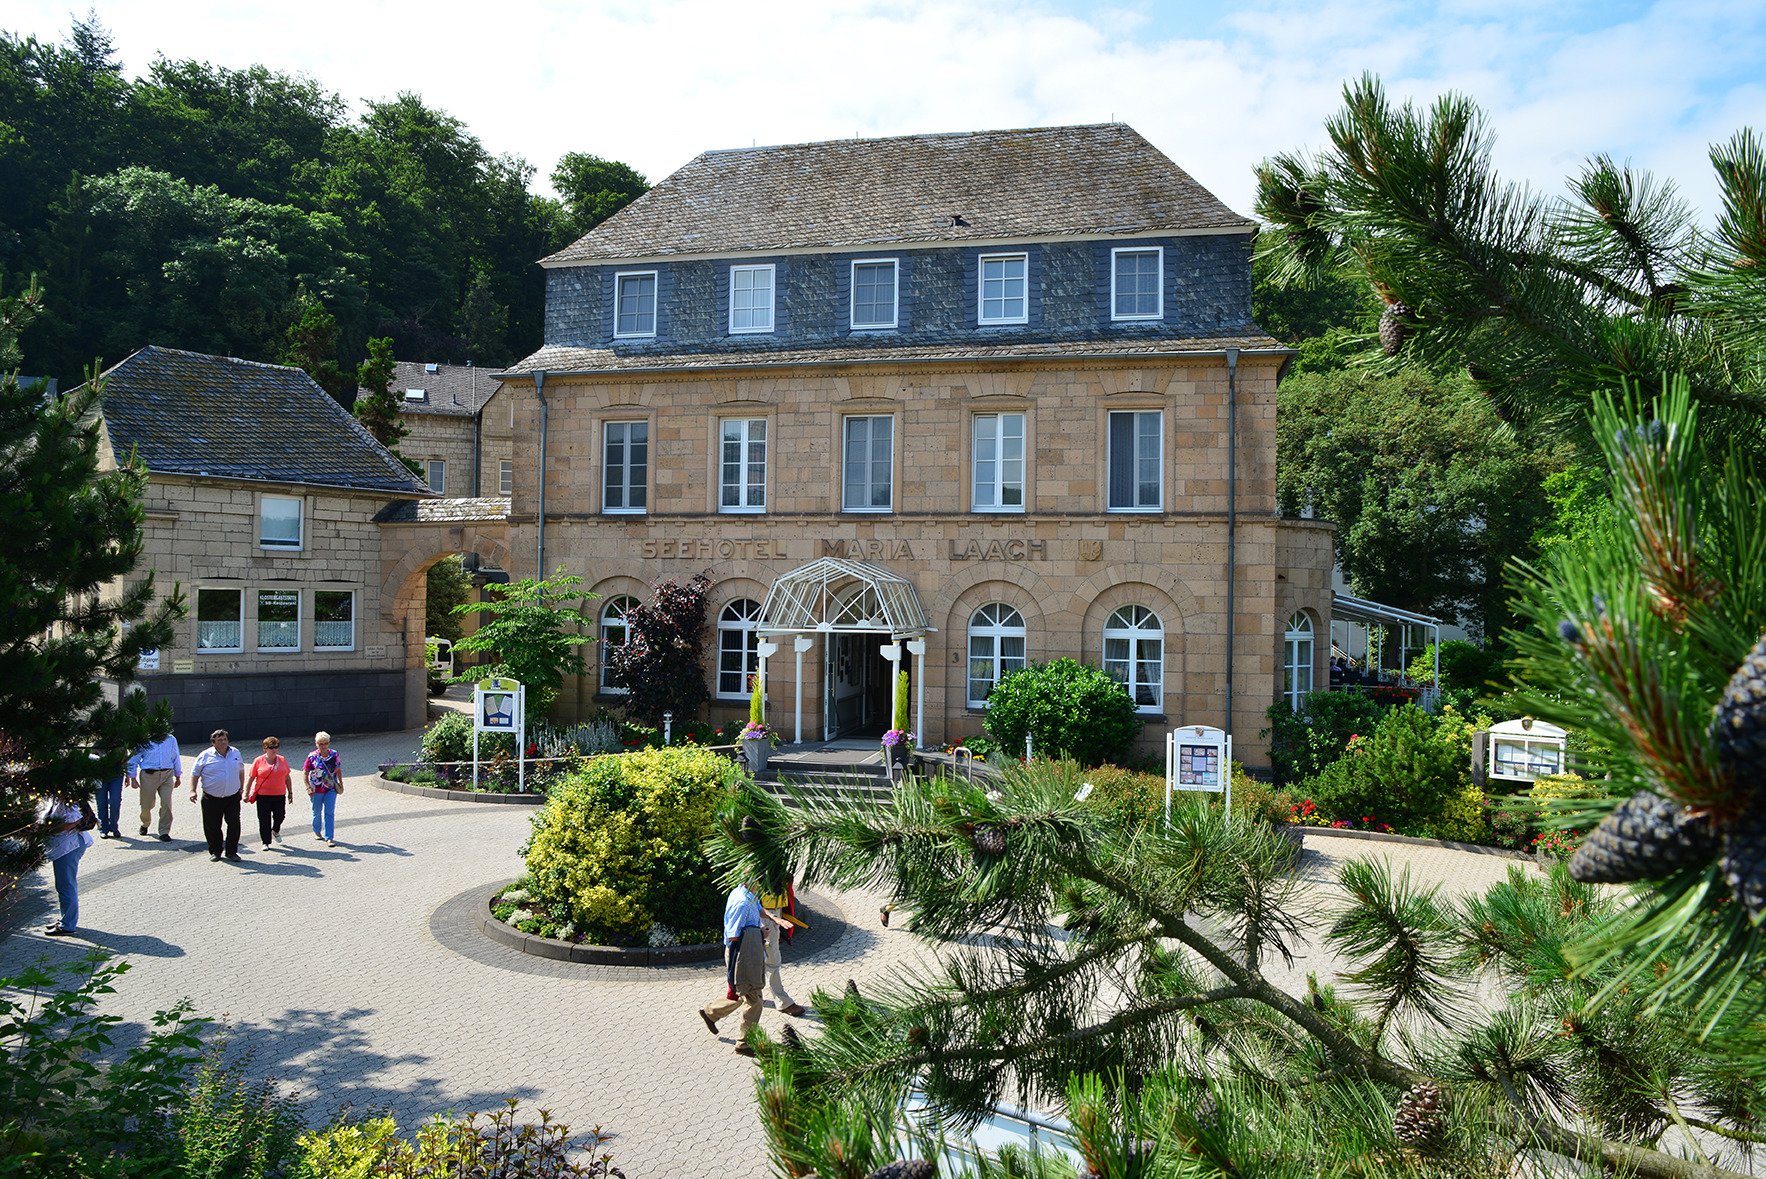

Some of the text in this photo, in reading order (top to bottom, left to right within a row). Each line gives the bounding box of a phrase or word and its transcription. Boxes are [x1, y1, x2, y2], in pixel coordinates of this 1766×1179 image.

[641, 538, 1047, 561] SEEHOTEL MARIA LAACH
[952, 651, 960, 664] 3
